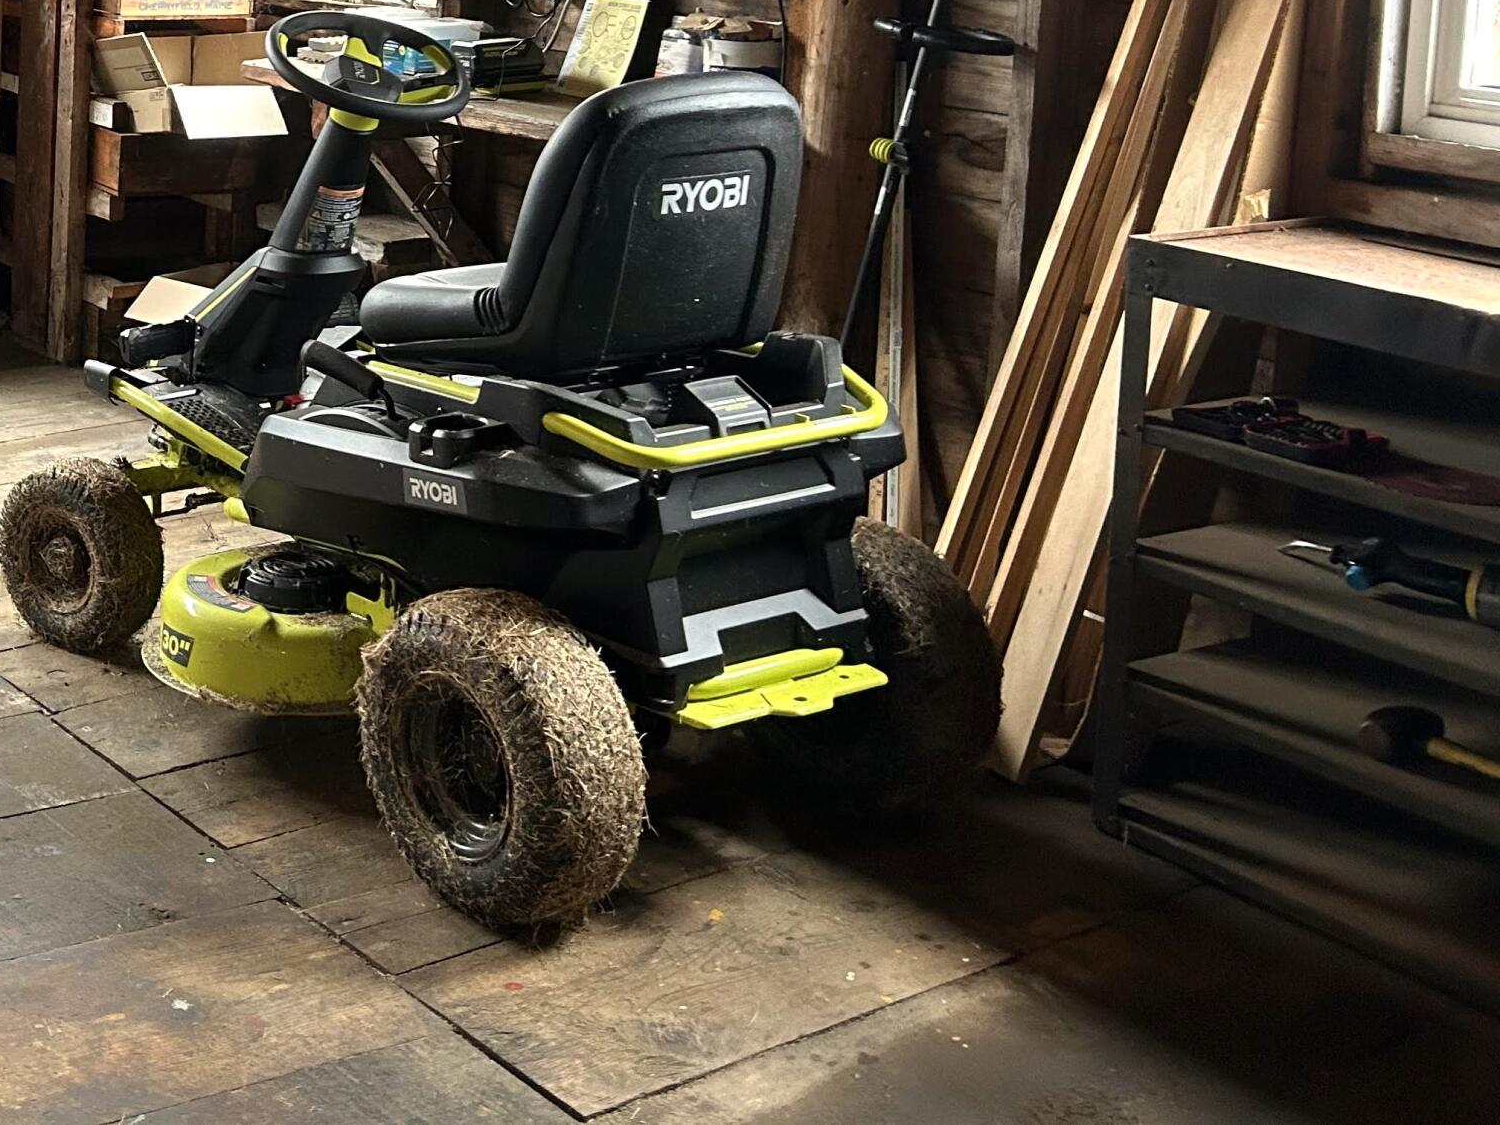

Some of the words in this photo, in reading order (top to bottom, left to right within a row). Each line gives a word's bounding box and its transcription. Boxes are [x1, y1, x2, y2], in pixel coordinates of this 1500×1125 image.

[660, 174, 751, 215] RYOBI
[409, 477, 458, 506] RYOBI
[162, 629, 191, 656] 30"
